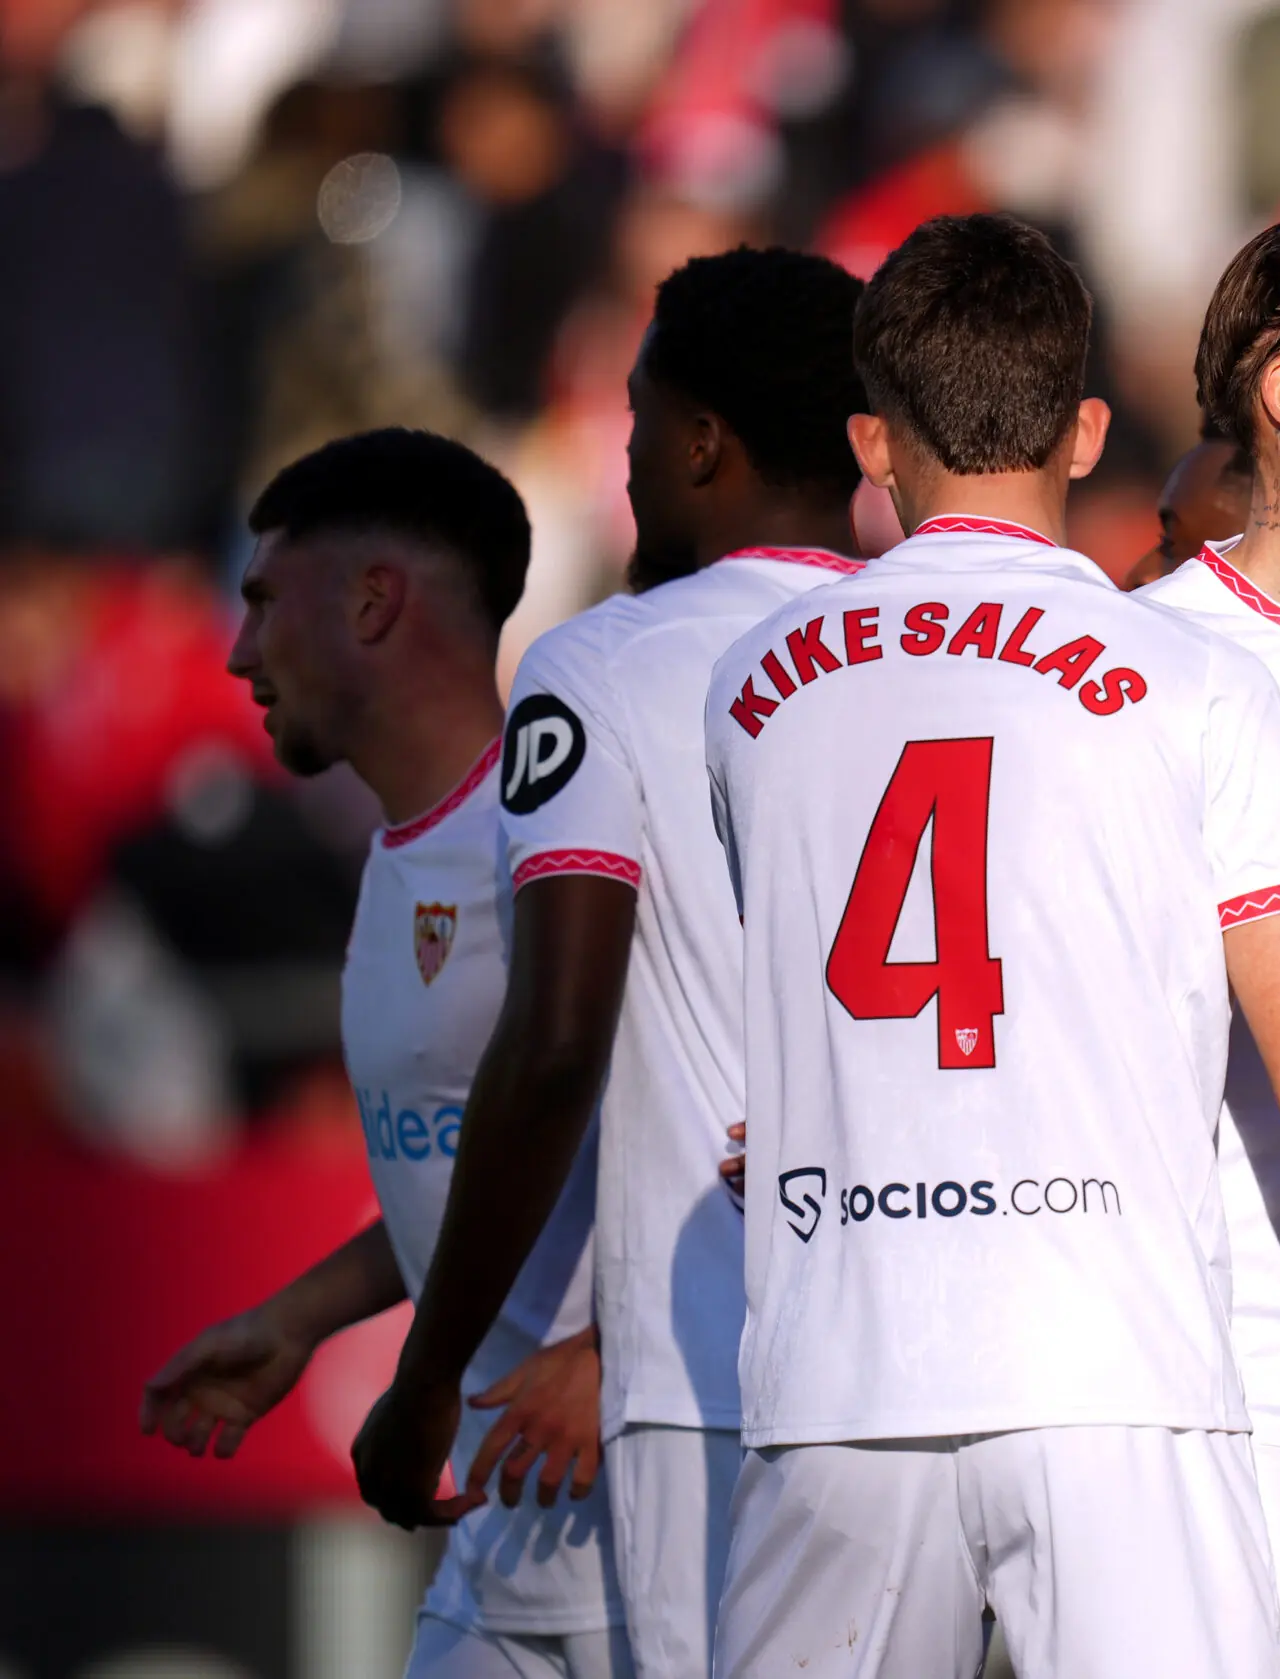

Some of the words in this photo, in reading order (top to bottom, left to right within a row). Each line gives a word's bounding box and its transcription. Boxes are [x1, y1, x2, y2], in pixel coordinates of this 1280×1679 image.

[729, 606, 883, 739] KIKE
[899, 601, 1148, 716] SALAS
[505, 715, 574, 801] JD
[825, 736, 1005, 1070] 4
